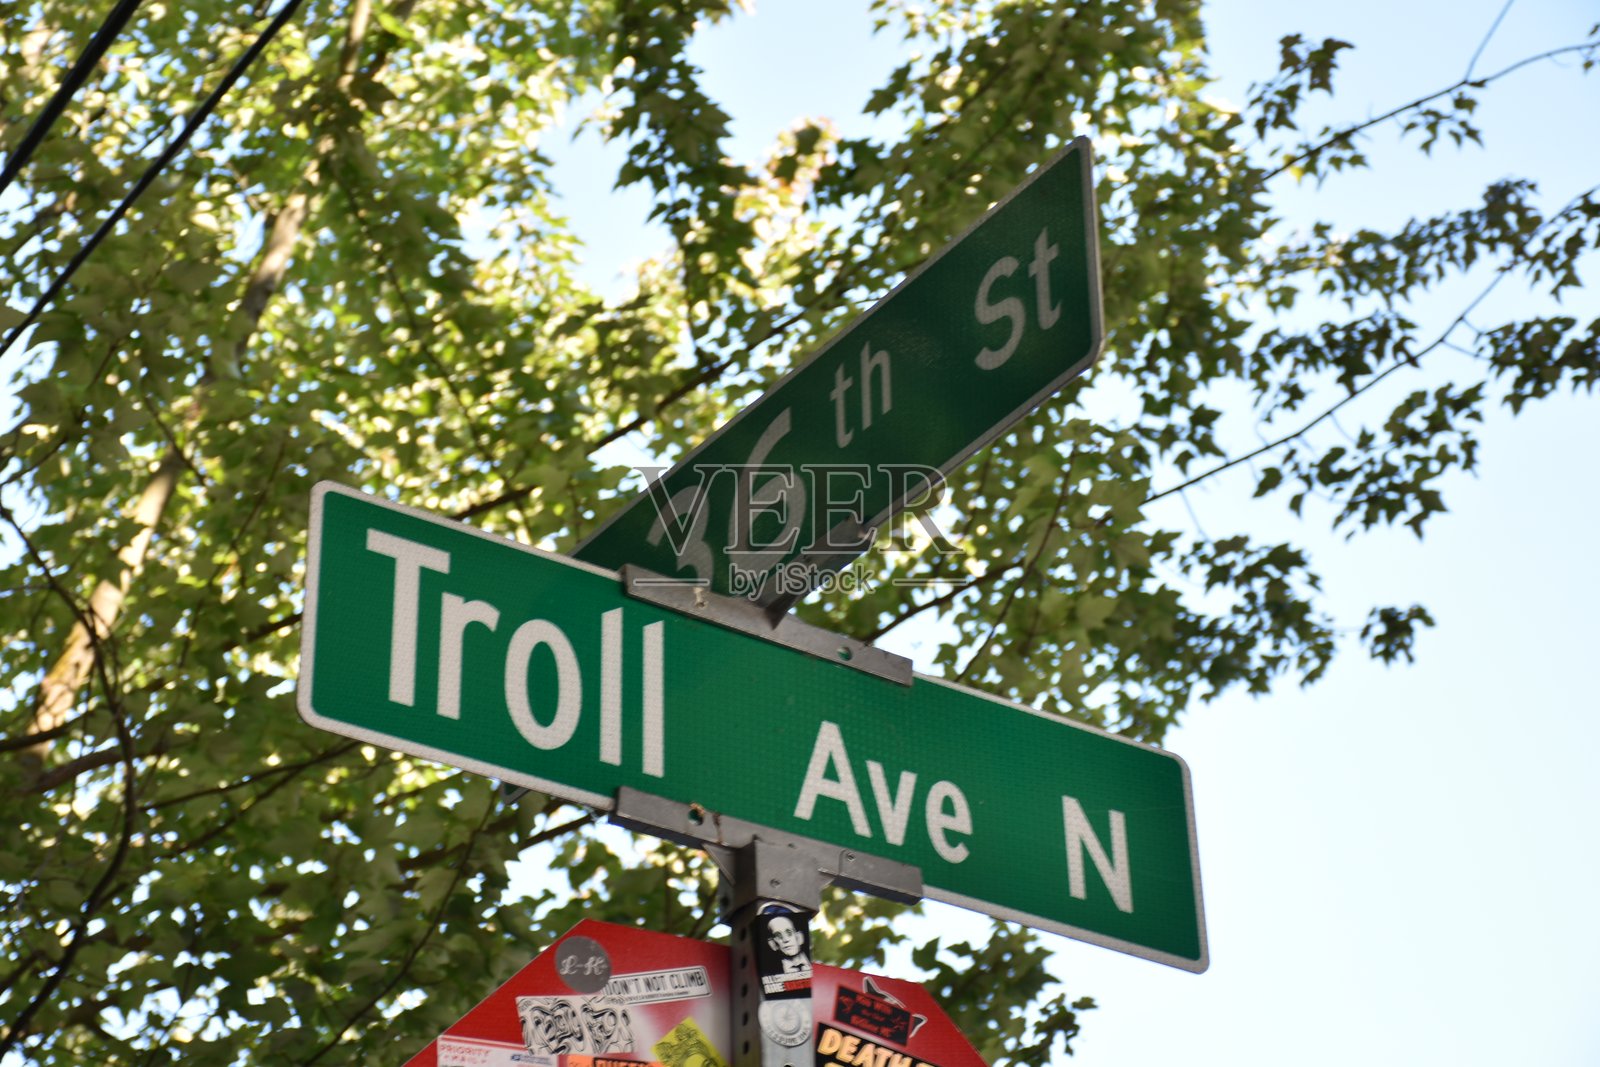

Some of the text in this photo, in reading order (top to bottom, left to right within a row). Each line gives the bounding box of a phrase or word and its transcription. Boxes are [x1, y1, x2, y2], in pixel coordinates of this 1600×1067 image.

[975, 227, 1062, 371] St
[366, 528, 1133, 913] Troll Ave N
